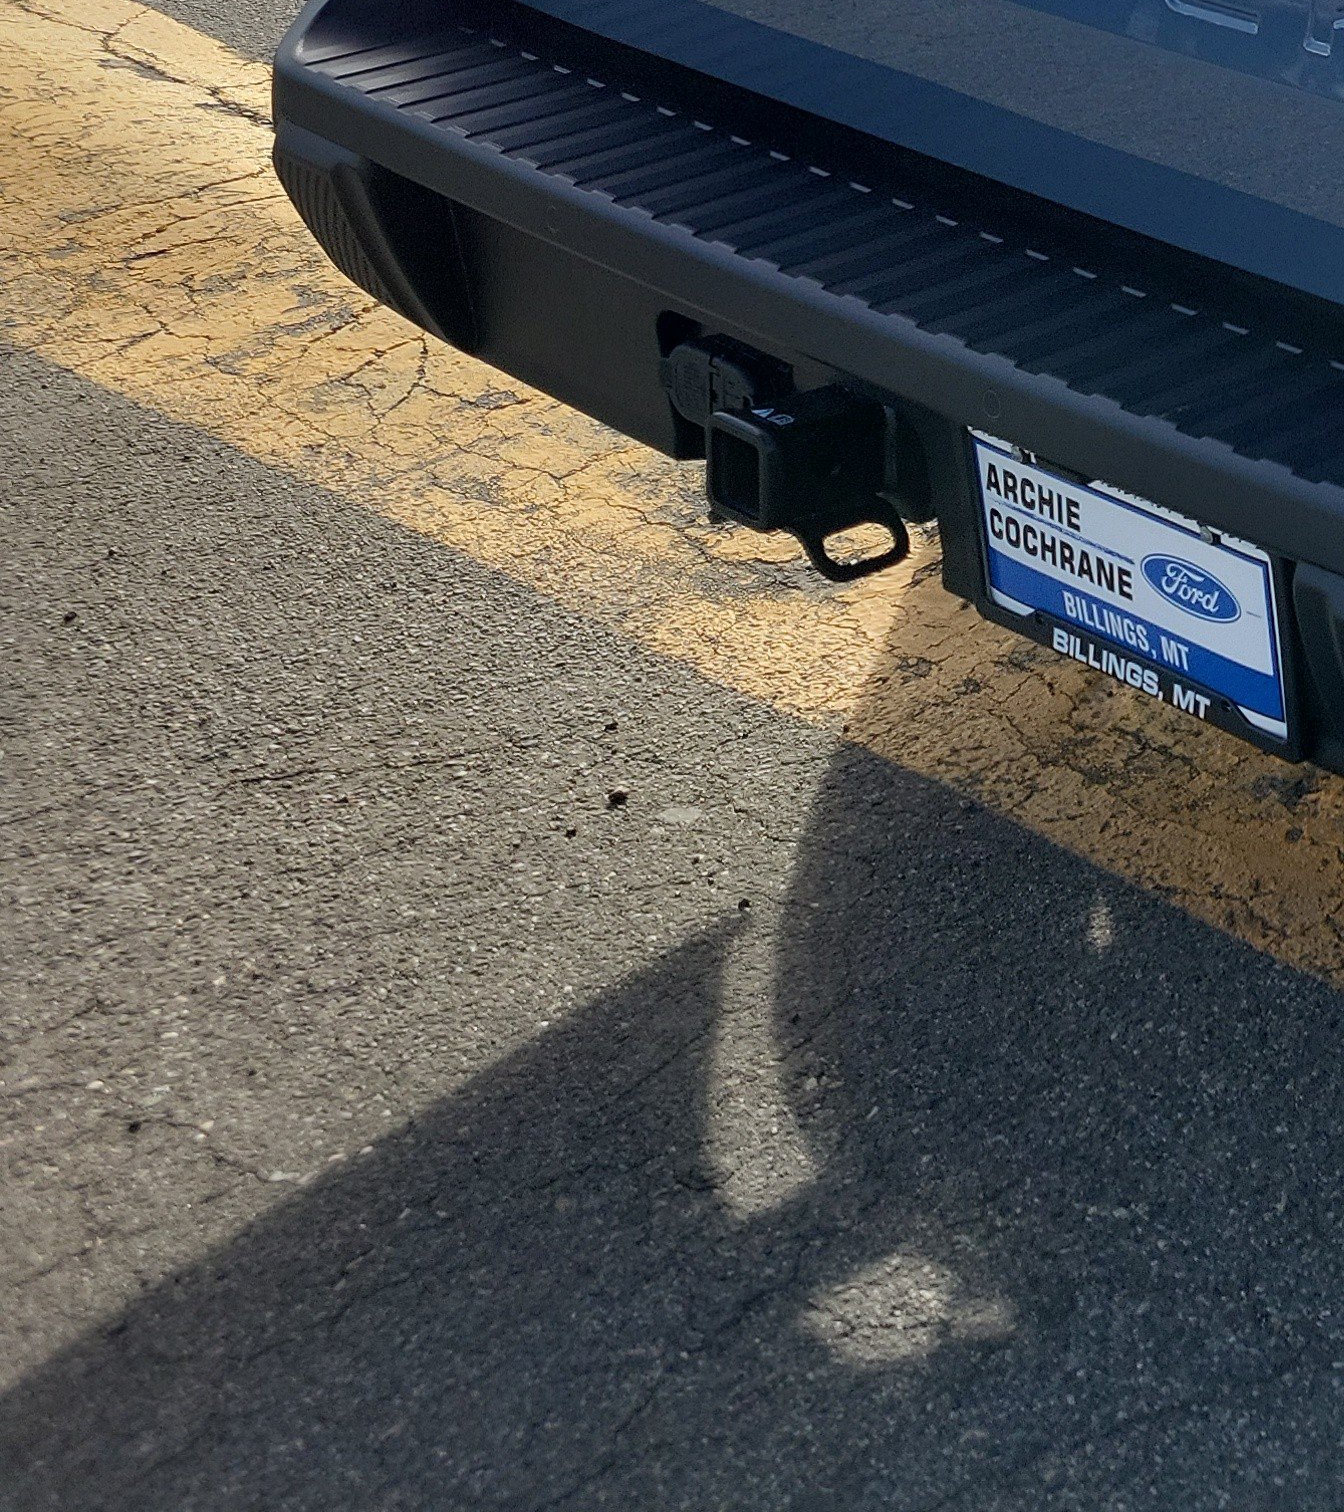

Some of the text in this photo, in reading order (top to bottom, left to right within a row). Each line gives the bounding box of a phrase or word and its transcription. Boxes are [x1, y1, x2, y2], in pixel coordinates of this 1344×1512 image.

[986, 462, 1082, 533] ARCHIE
[989, 507, 1134, 601] COCHRANE
[1161, 560, 1221, 614] Ford
[1062, 590, 1190, 671] BILLINGS, MT
[1052, 626, 1212, 719] BILLINGS, MT
